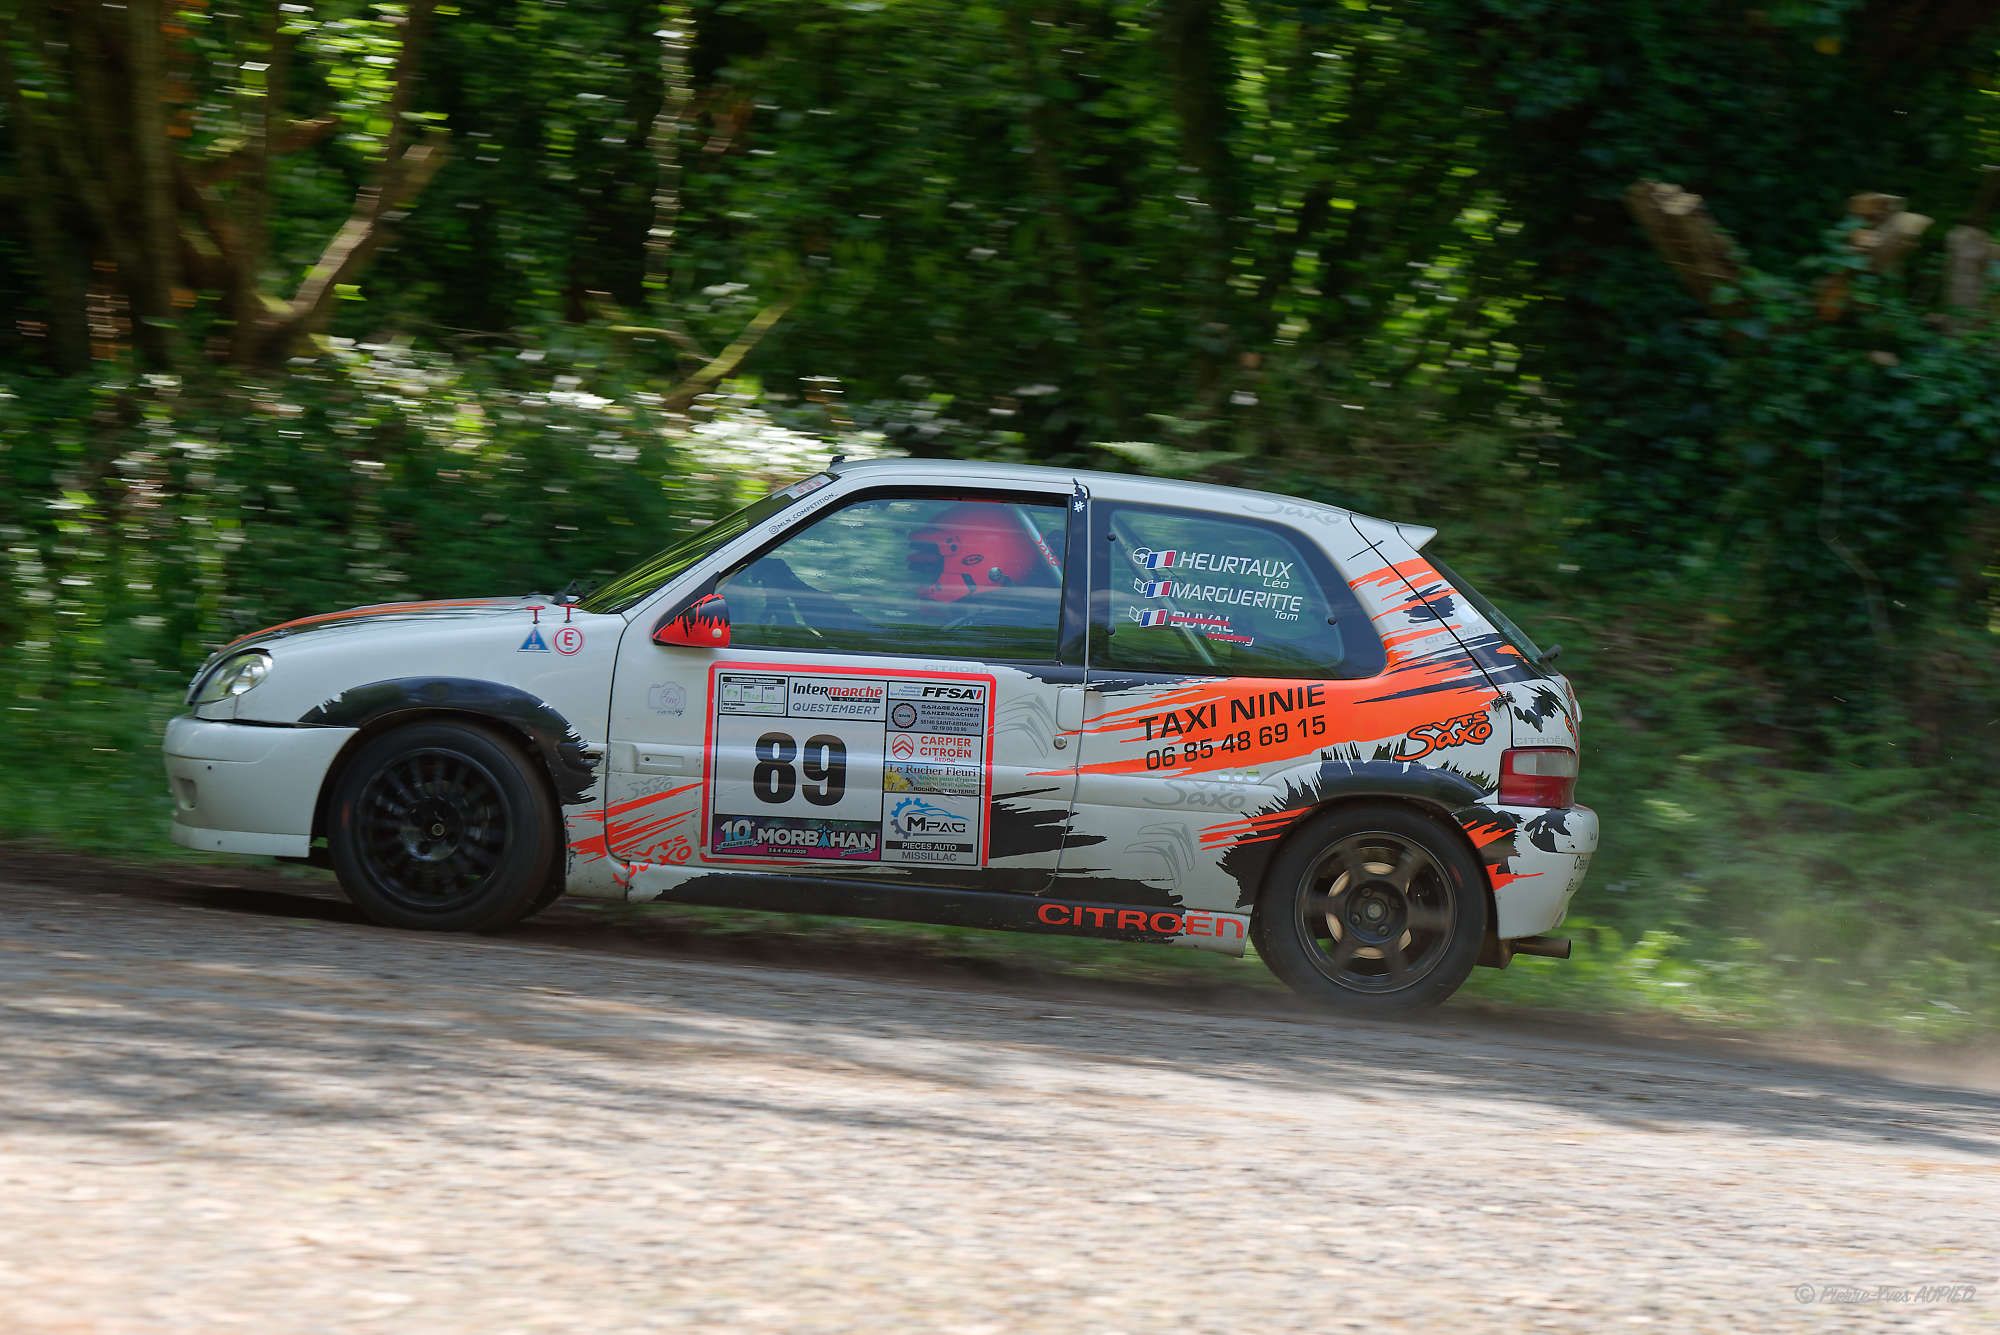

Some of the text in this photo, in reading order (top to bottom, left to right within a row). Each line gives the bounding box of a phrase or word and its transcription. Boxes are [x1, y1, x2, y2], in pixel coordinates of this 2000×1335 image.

[1178, 551, 1294, 580] HEURTAUX
[1263, 577, 1289, 589] Léo
[1170, 582, 1304, 613] MARGUERITTE
[1274, 610, 1299, 622] Tom
[792, 682, 883, 699] Intermarché
[921, 686, 976, 700] FFSA
[792, 702, 880, 715] QUESTEMBERT
[1138, 683, 1326, 741] TAXI NINIE
[920, 736, 971, 747] CARPIER
[1146, 714, 1326, 770] 06 85 48 69 15
[1394, 722, 1493, 761] Saxo
[920, 746, 972, 758] CITROËN
[753, 731, 847, 807] 89
[889, 764, 976, 777] Le Rucher Fleuri
[907, 816, 966, 832] MPAC
[901, 842, 932, 850] PIECES
[901, 851, 957, 861] MISSILLAC
[1037, 903, 1244, 939] CITROËN
